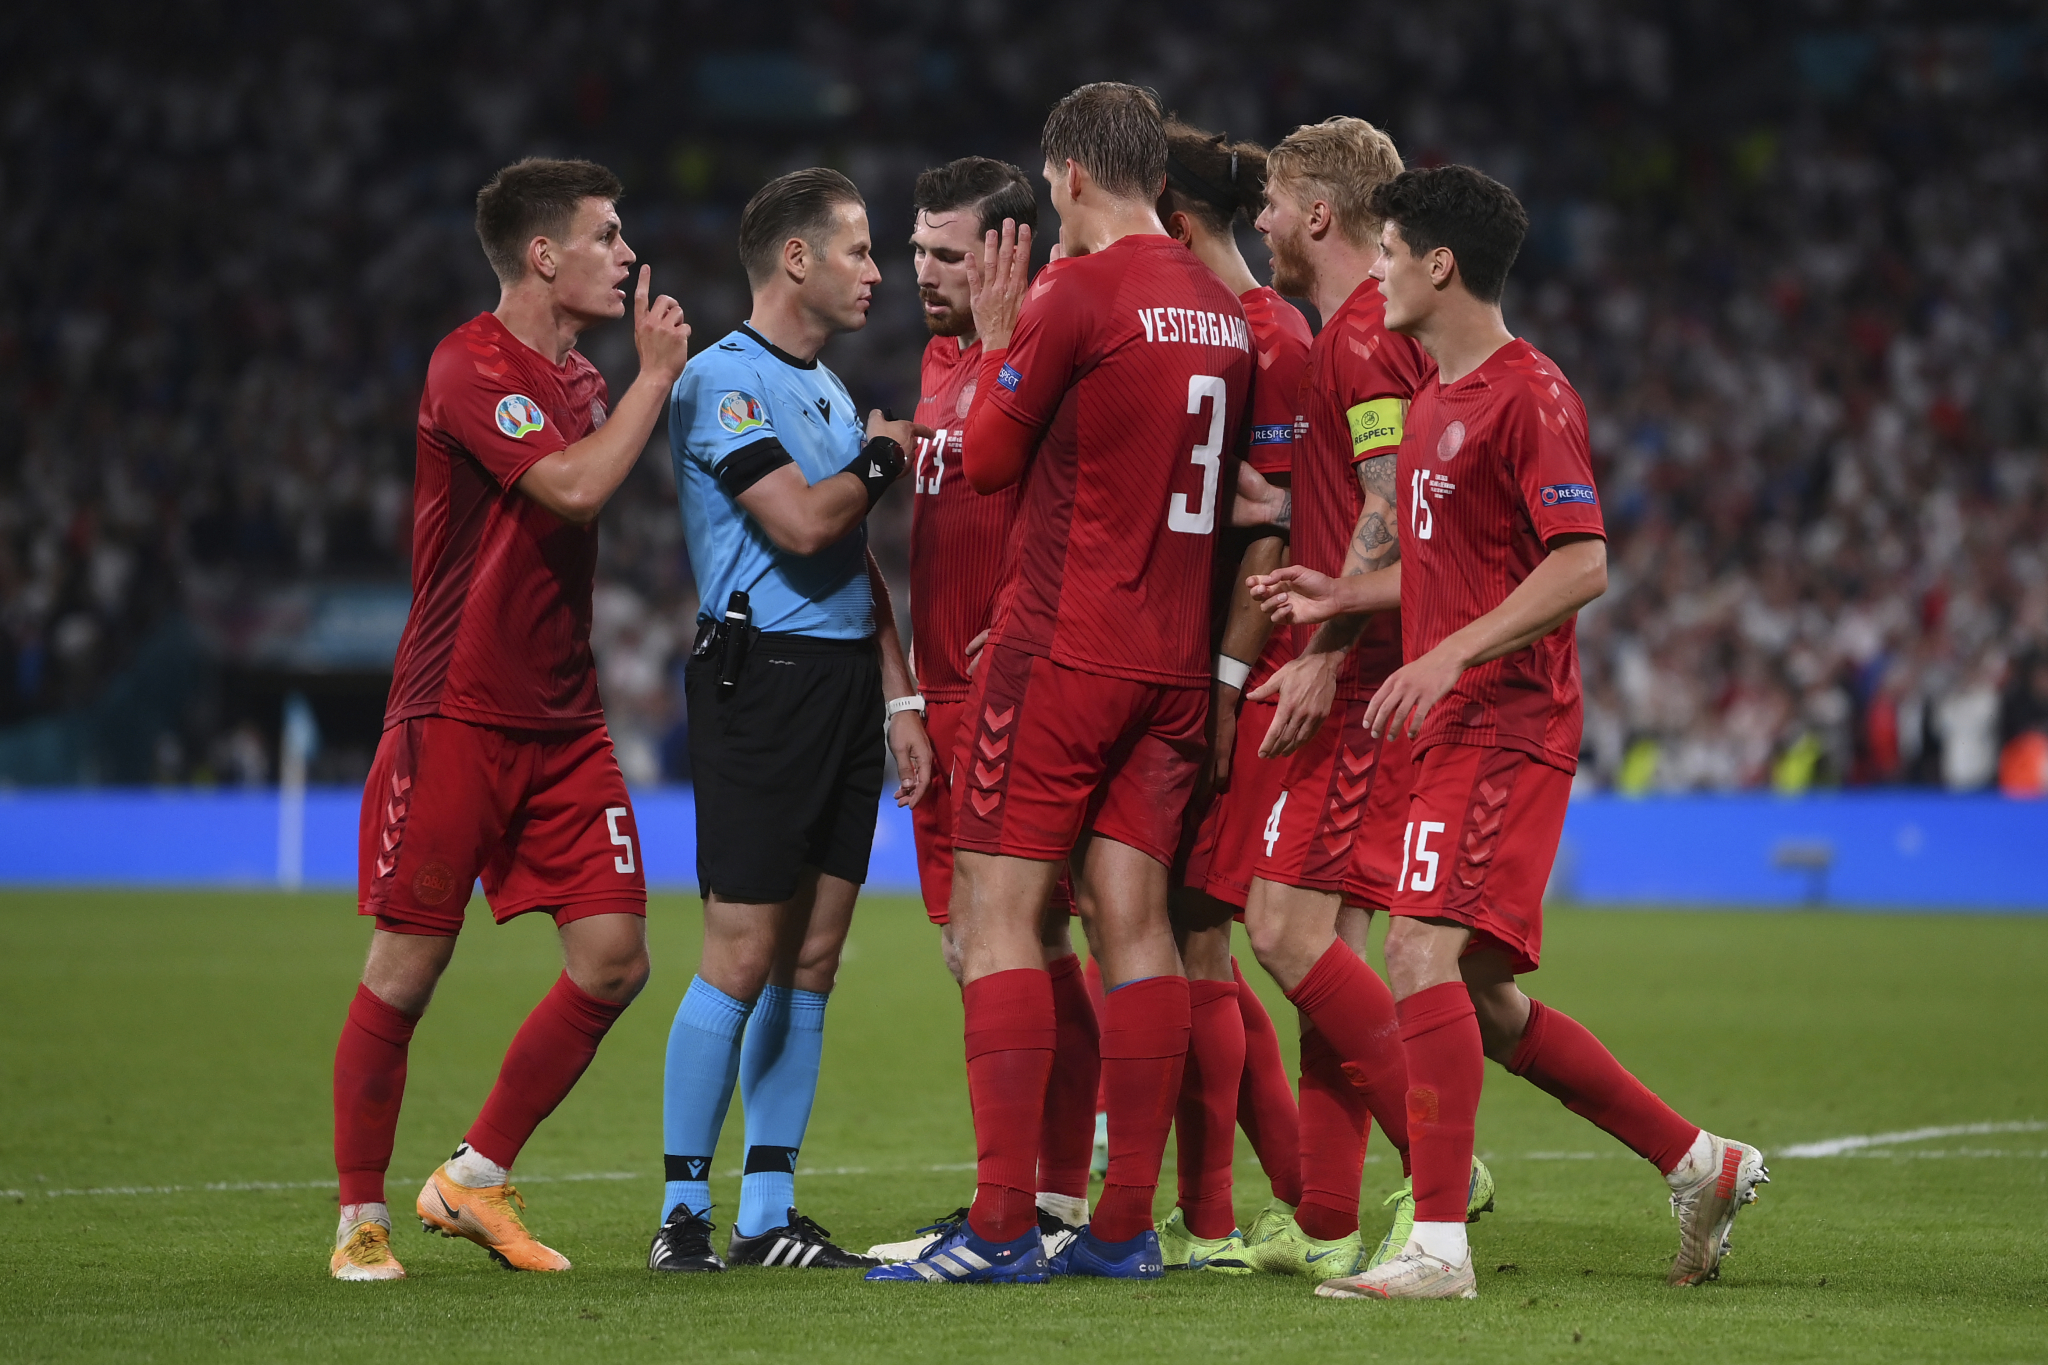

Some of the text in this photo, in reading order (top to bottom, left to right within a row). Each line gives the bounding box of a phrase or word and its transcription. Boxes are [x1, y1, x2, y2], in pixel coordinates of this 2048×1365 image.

[1137, 307, 1249, 354] VESTERGAARD
[1167, 374, 1227, 535] 3
[1255, 428, 1292, 441] RESPEC
[1354, 427, 1395, 445] RESPECT
[1411, 469, 1433, 540] 15
[1558, 488, 1594, 500] RESPECT
[605, 807, 636, 874] 5
[1263, 790, 1289, 858] 4
[1397, 820, 1446, 893] 15
